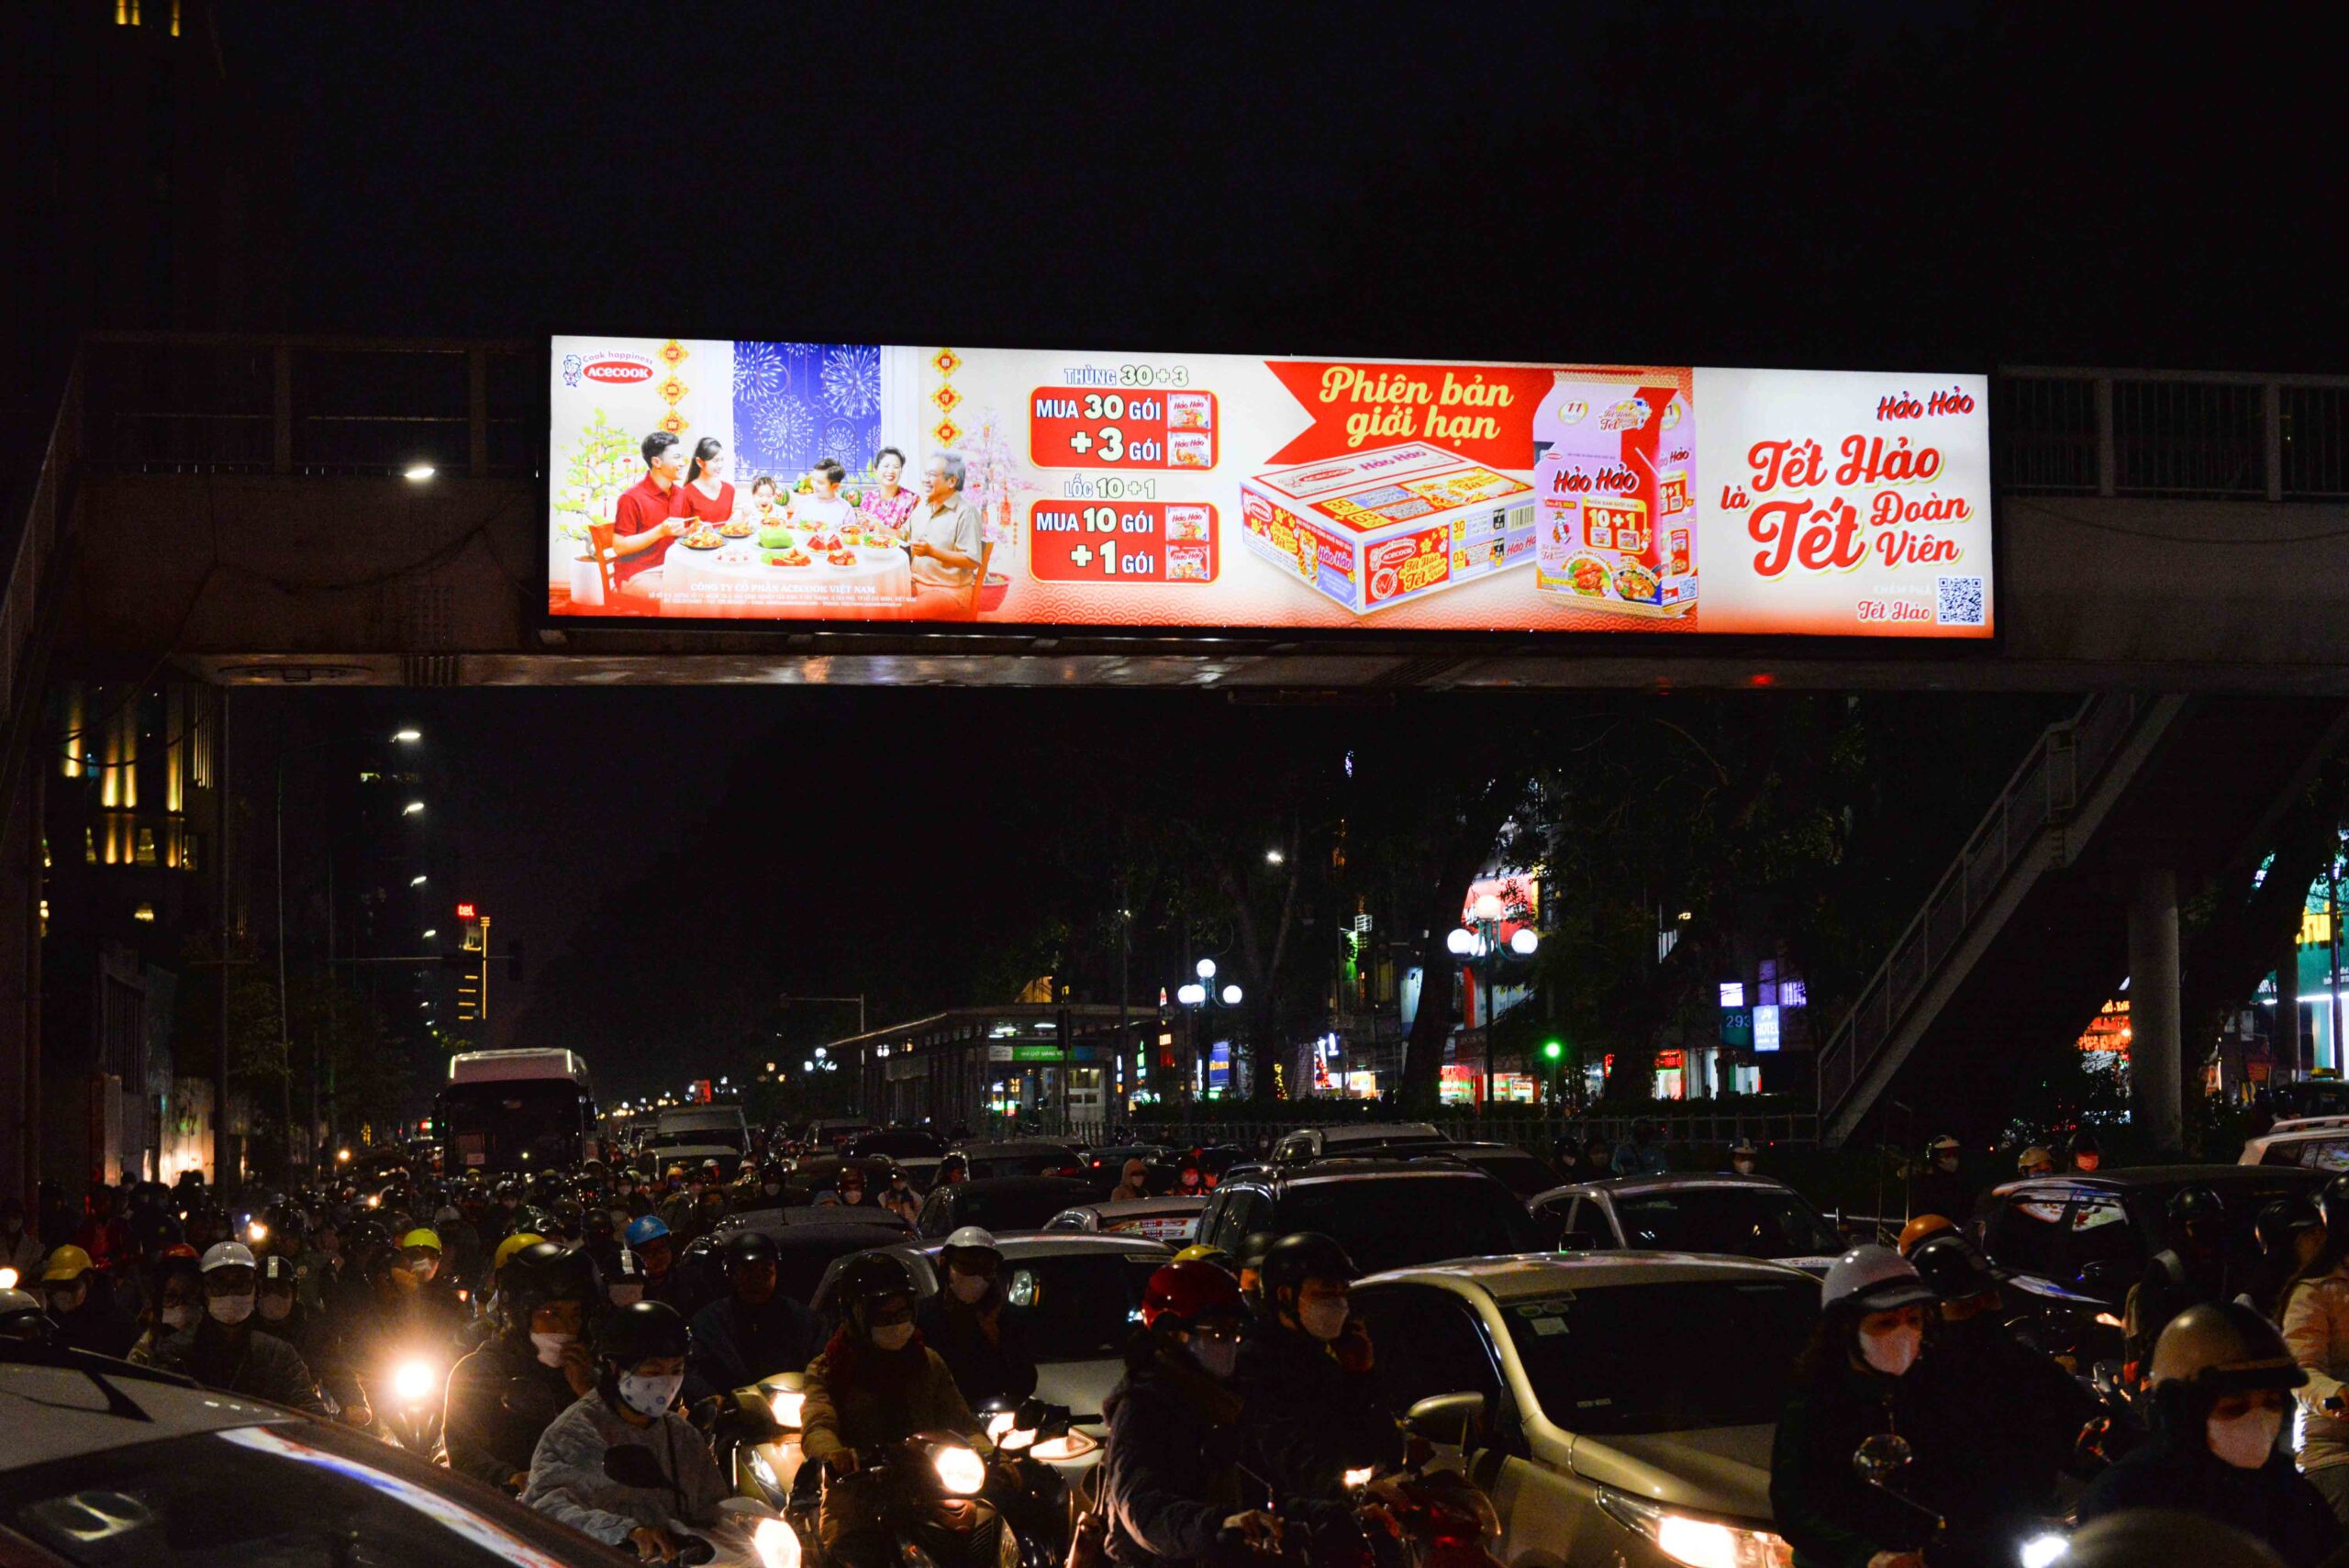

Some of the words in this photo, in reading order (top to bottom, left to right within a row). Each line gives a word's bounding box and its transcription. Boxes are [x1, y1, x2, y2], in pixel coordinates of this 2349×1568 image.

[583, 351, 606, 362] Cook
[608, 351, 653, 365] happiness
[1064, 365, 1117, 385] THÙNG
[1319, 366, 1432, 404] Phiên
[1440, 372, 1514, 407] bản
[1036, 399, 1079, 418] MUA
[1084, 394, 1125, 420] 30
[1129, 398, 1161, 420] GÓI
[1877, 390, 1922, 421] Hảo
[1928, 386, 1975, 417] Hảo
[1346, 405, 1417, 448] giới
[1423, 405, 1501, 447] hạn
[1129, 439, 1161, 461] GÓI
[1747, 438, 1828, 493] Tết
[1835, 434, 1940, 486] Hảo
[1064, 474, 1093, 498] LỐC
[1553, 465, 1593, 494] Hảo
[1596, 463, 1638, 492] Hảo
[1720, 485, 1750, 510] là
[1036, 512, 1079, 531] MUA
[1083, 506, 1117, 533] 10
[1122, 511, 1154, 533] GÓI
[1453, 520, 1465, 533] 30
[1747, 496, 1865, 577] Tết
[1871, 491, 1970, 527] Đoàn
[1453, 550, 1464, 562] 03
[1876, 531, 1960, 567] Viên
[1122, 552, 1154, 573] GÓI
[1857, 600, 1887, 620] Tết
[1891, 601, 1931, 620] Hảo
[1726, 1015, 1751, 1028] 293
